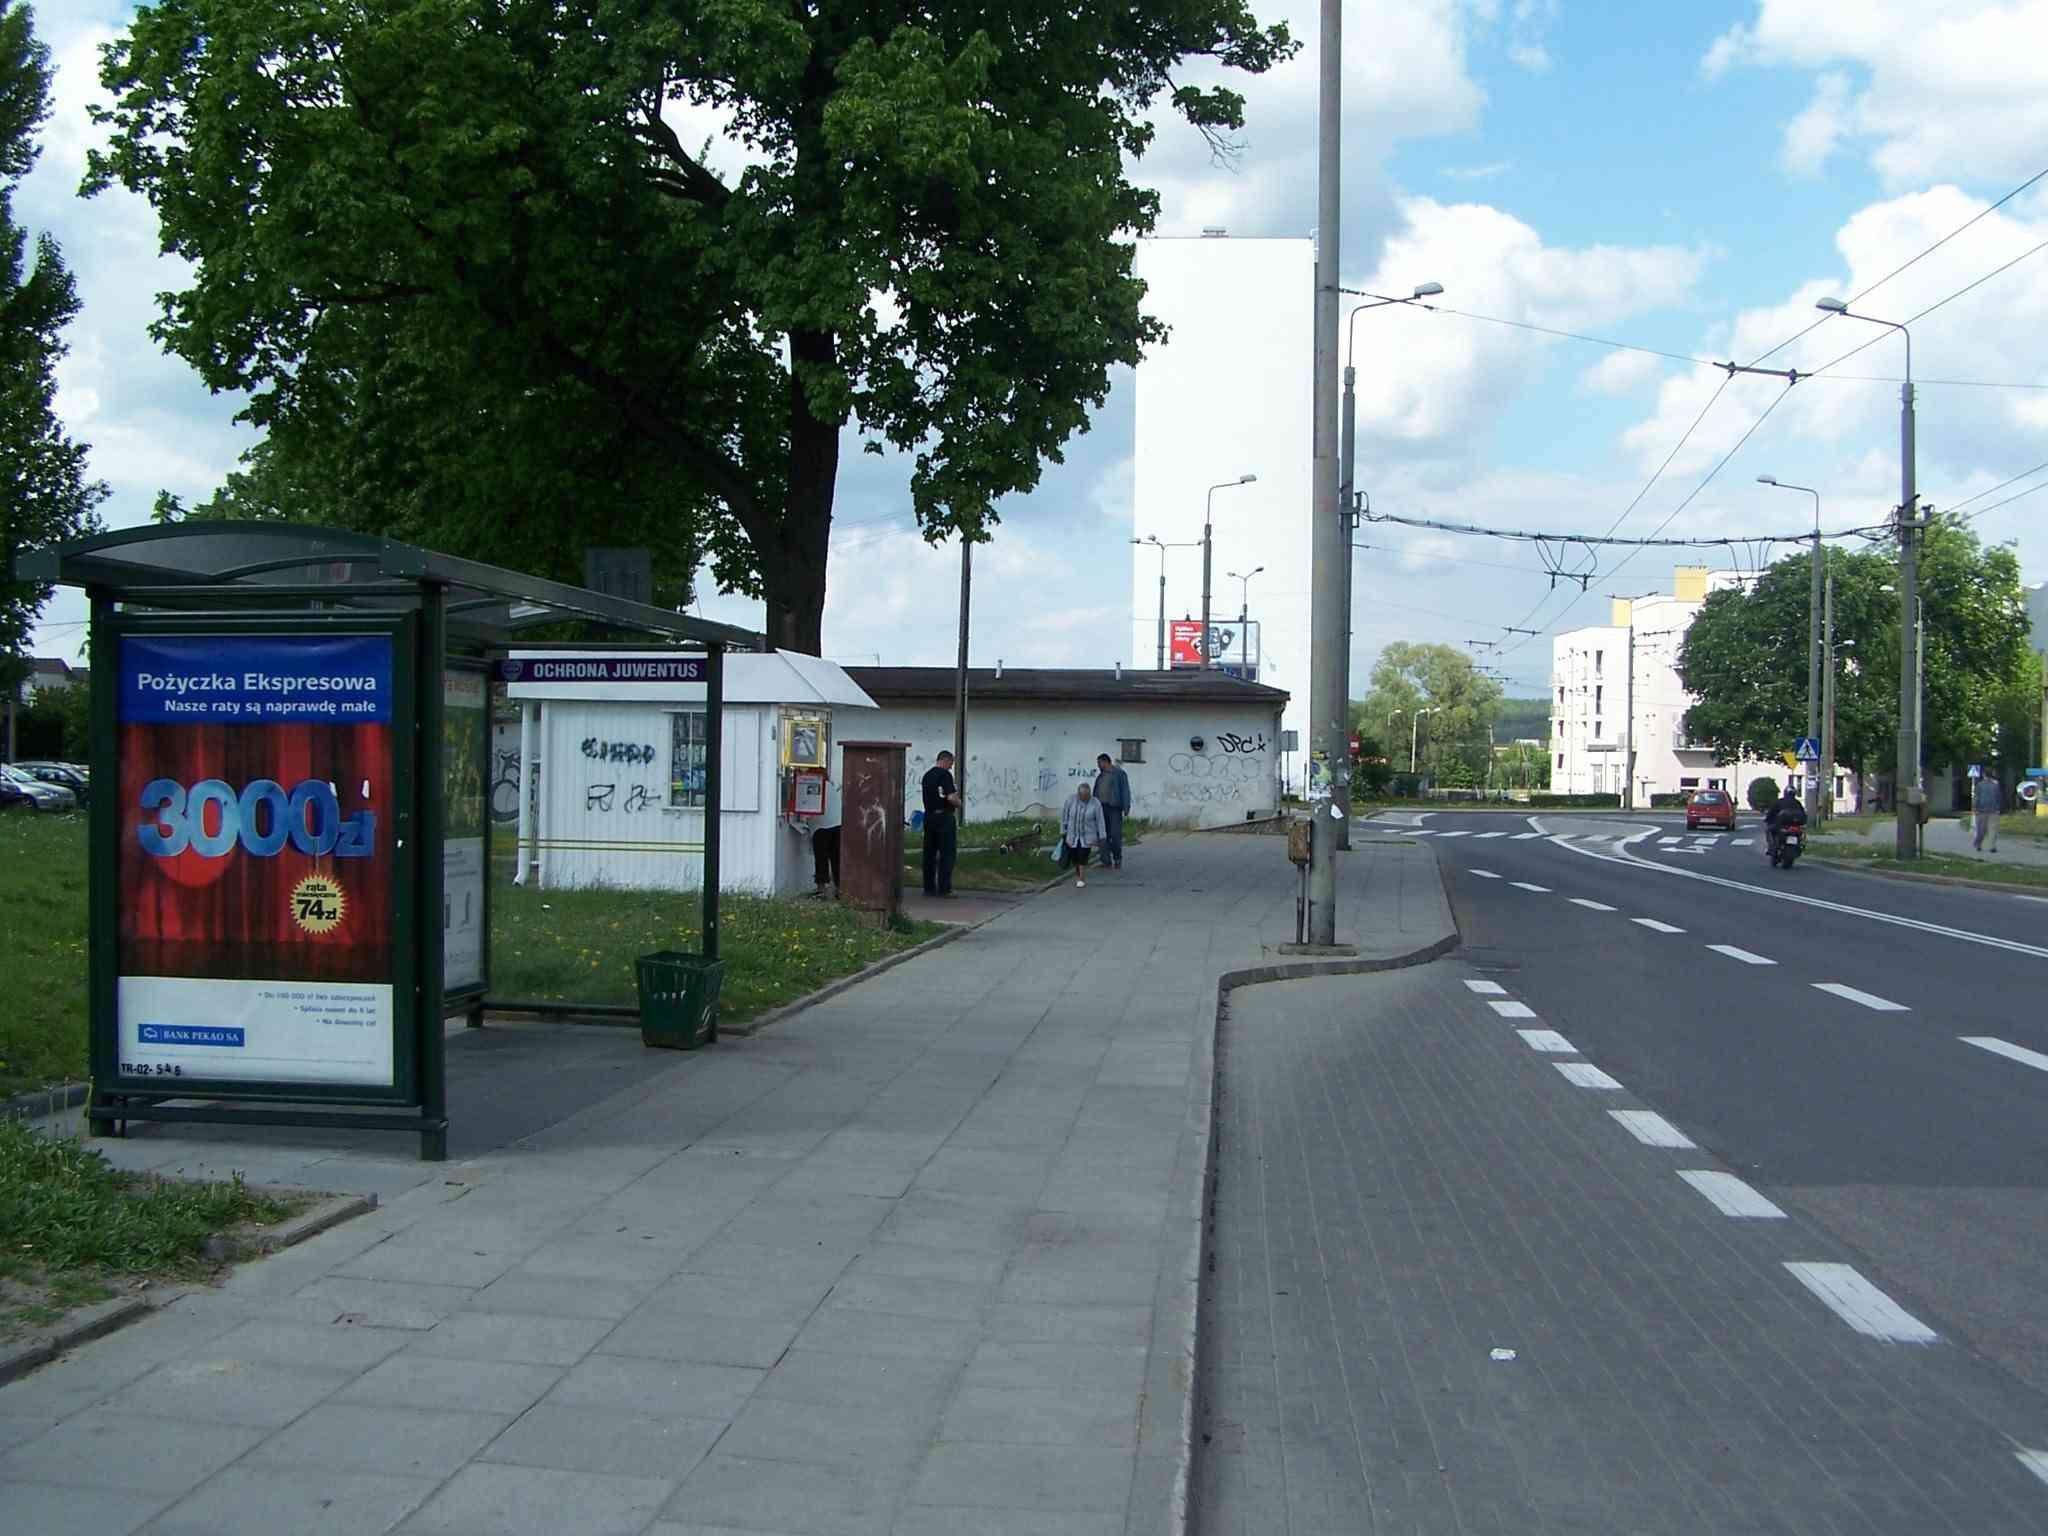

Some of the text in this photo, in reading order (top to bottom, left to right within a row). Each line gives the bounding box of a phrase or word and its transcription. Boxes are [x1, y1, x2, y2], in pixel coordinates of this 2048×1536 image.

[534, 663, 608, 678] OCHRONA
[612, 663, 698, 678] JUWENTUS
[137, 673, 377, 694] Pożyczka Ekspresowa
[164, 700, 377, 714] Nasze raty są naprawdę małe
[306, 883, 327, 892] rata
[164, 1031, 239, 1042] BANK PEKAO SA
